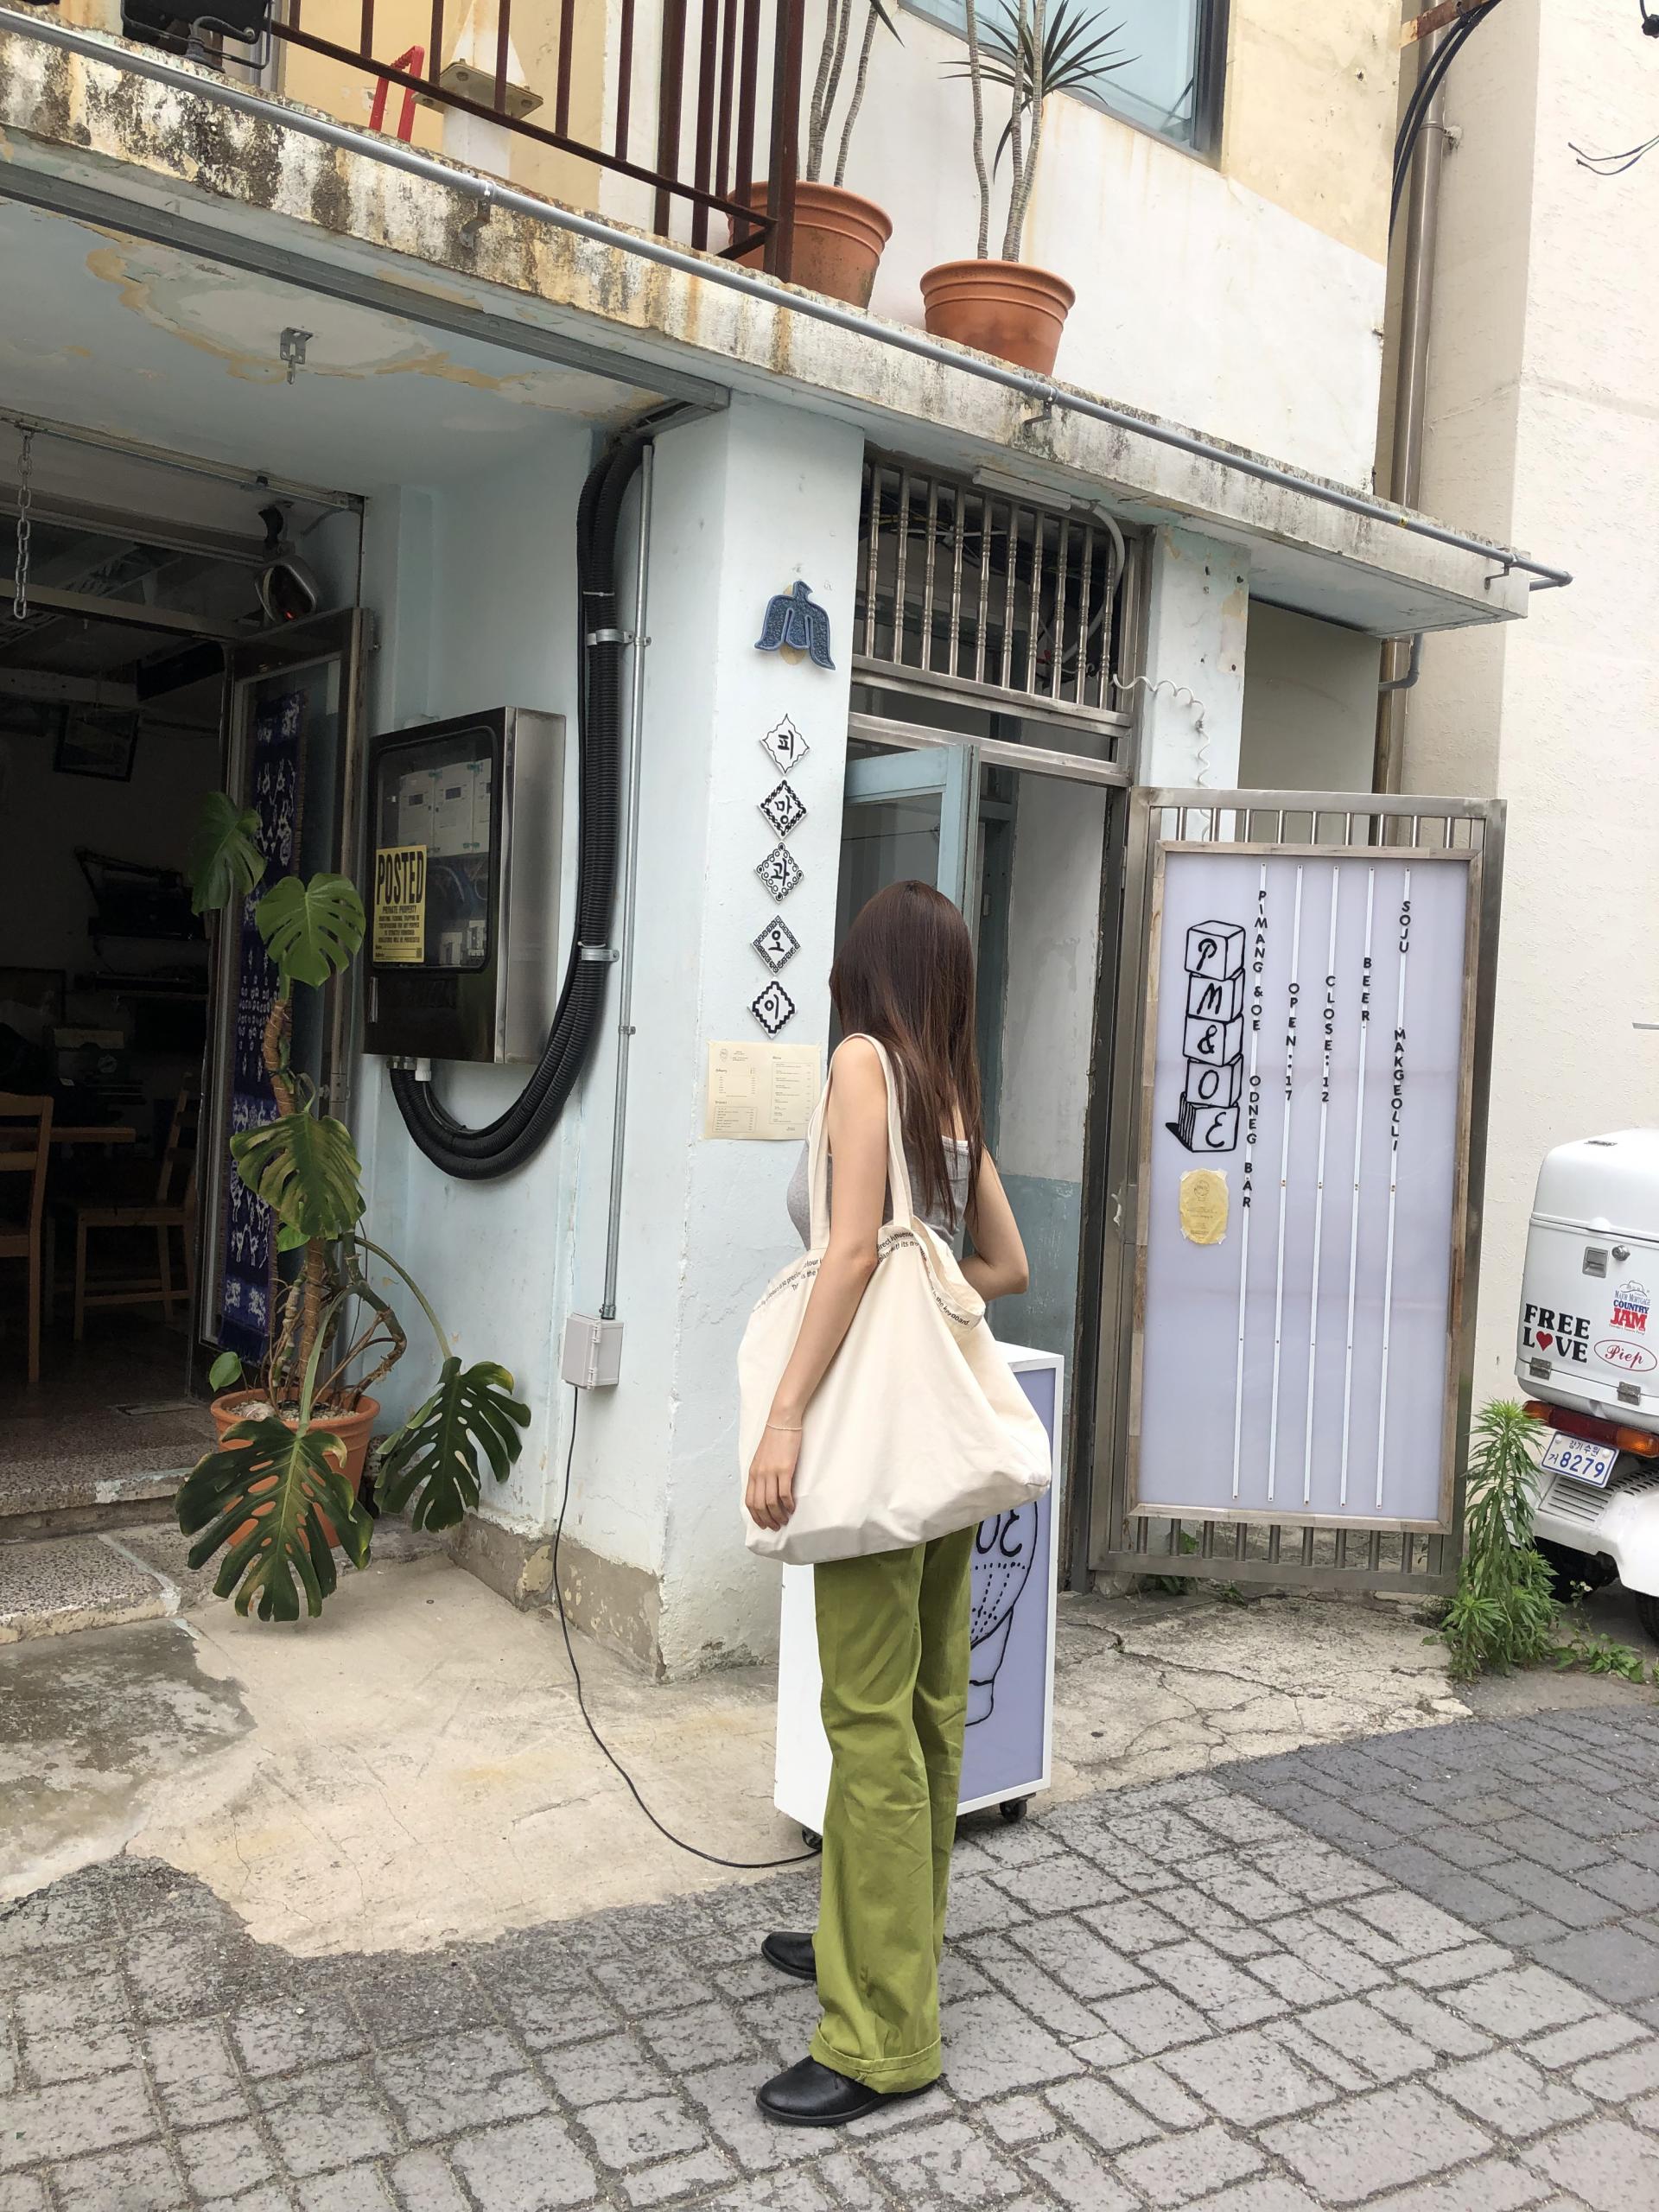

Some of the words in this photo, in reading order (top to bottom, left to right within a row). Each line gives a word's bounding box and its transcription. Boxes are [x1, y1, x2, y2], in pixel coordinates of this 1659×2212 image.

[376, 850, 424, 906] POSTED
[1399, 900, 1412, 953] SOJU
[1361, 957, 1372, 1022] BEER
[1246, 1075, 1262, 1145] ODNEG
[1390, 1028, 1407, 1152] MAKGEOLLI
[1242, 1161, 1253, 1208] BAR
[1523, 1302, 1591, 1340] FREE
[1610, 1306, 1648, 1332] JAM
[1613, 1299, 1650, 1314] COUNTRY
[1605, 1344, 1643, 1369] Piep
[1560, 1451, 1605, 1478] 8279
